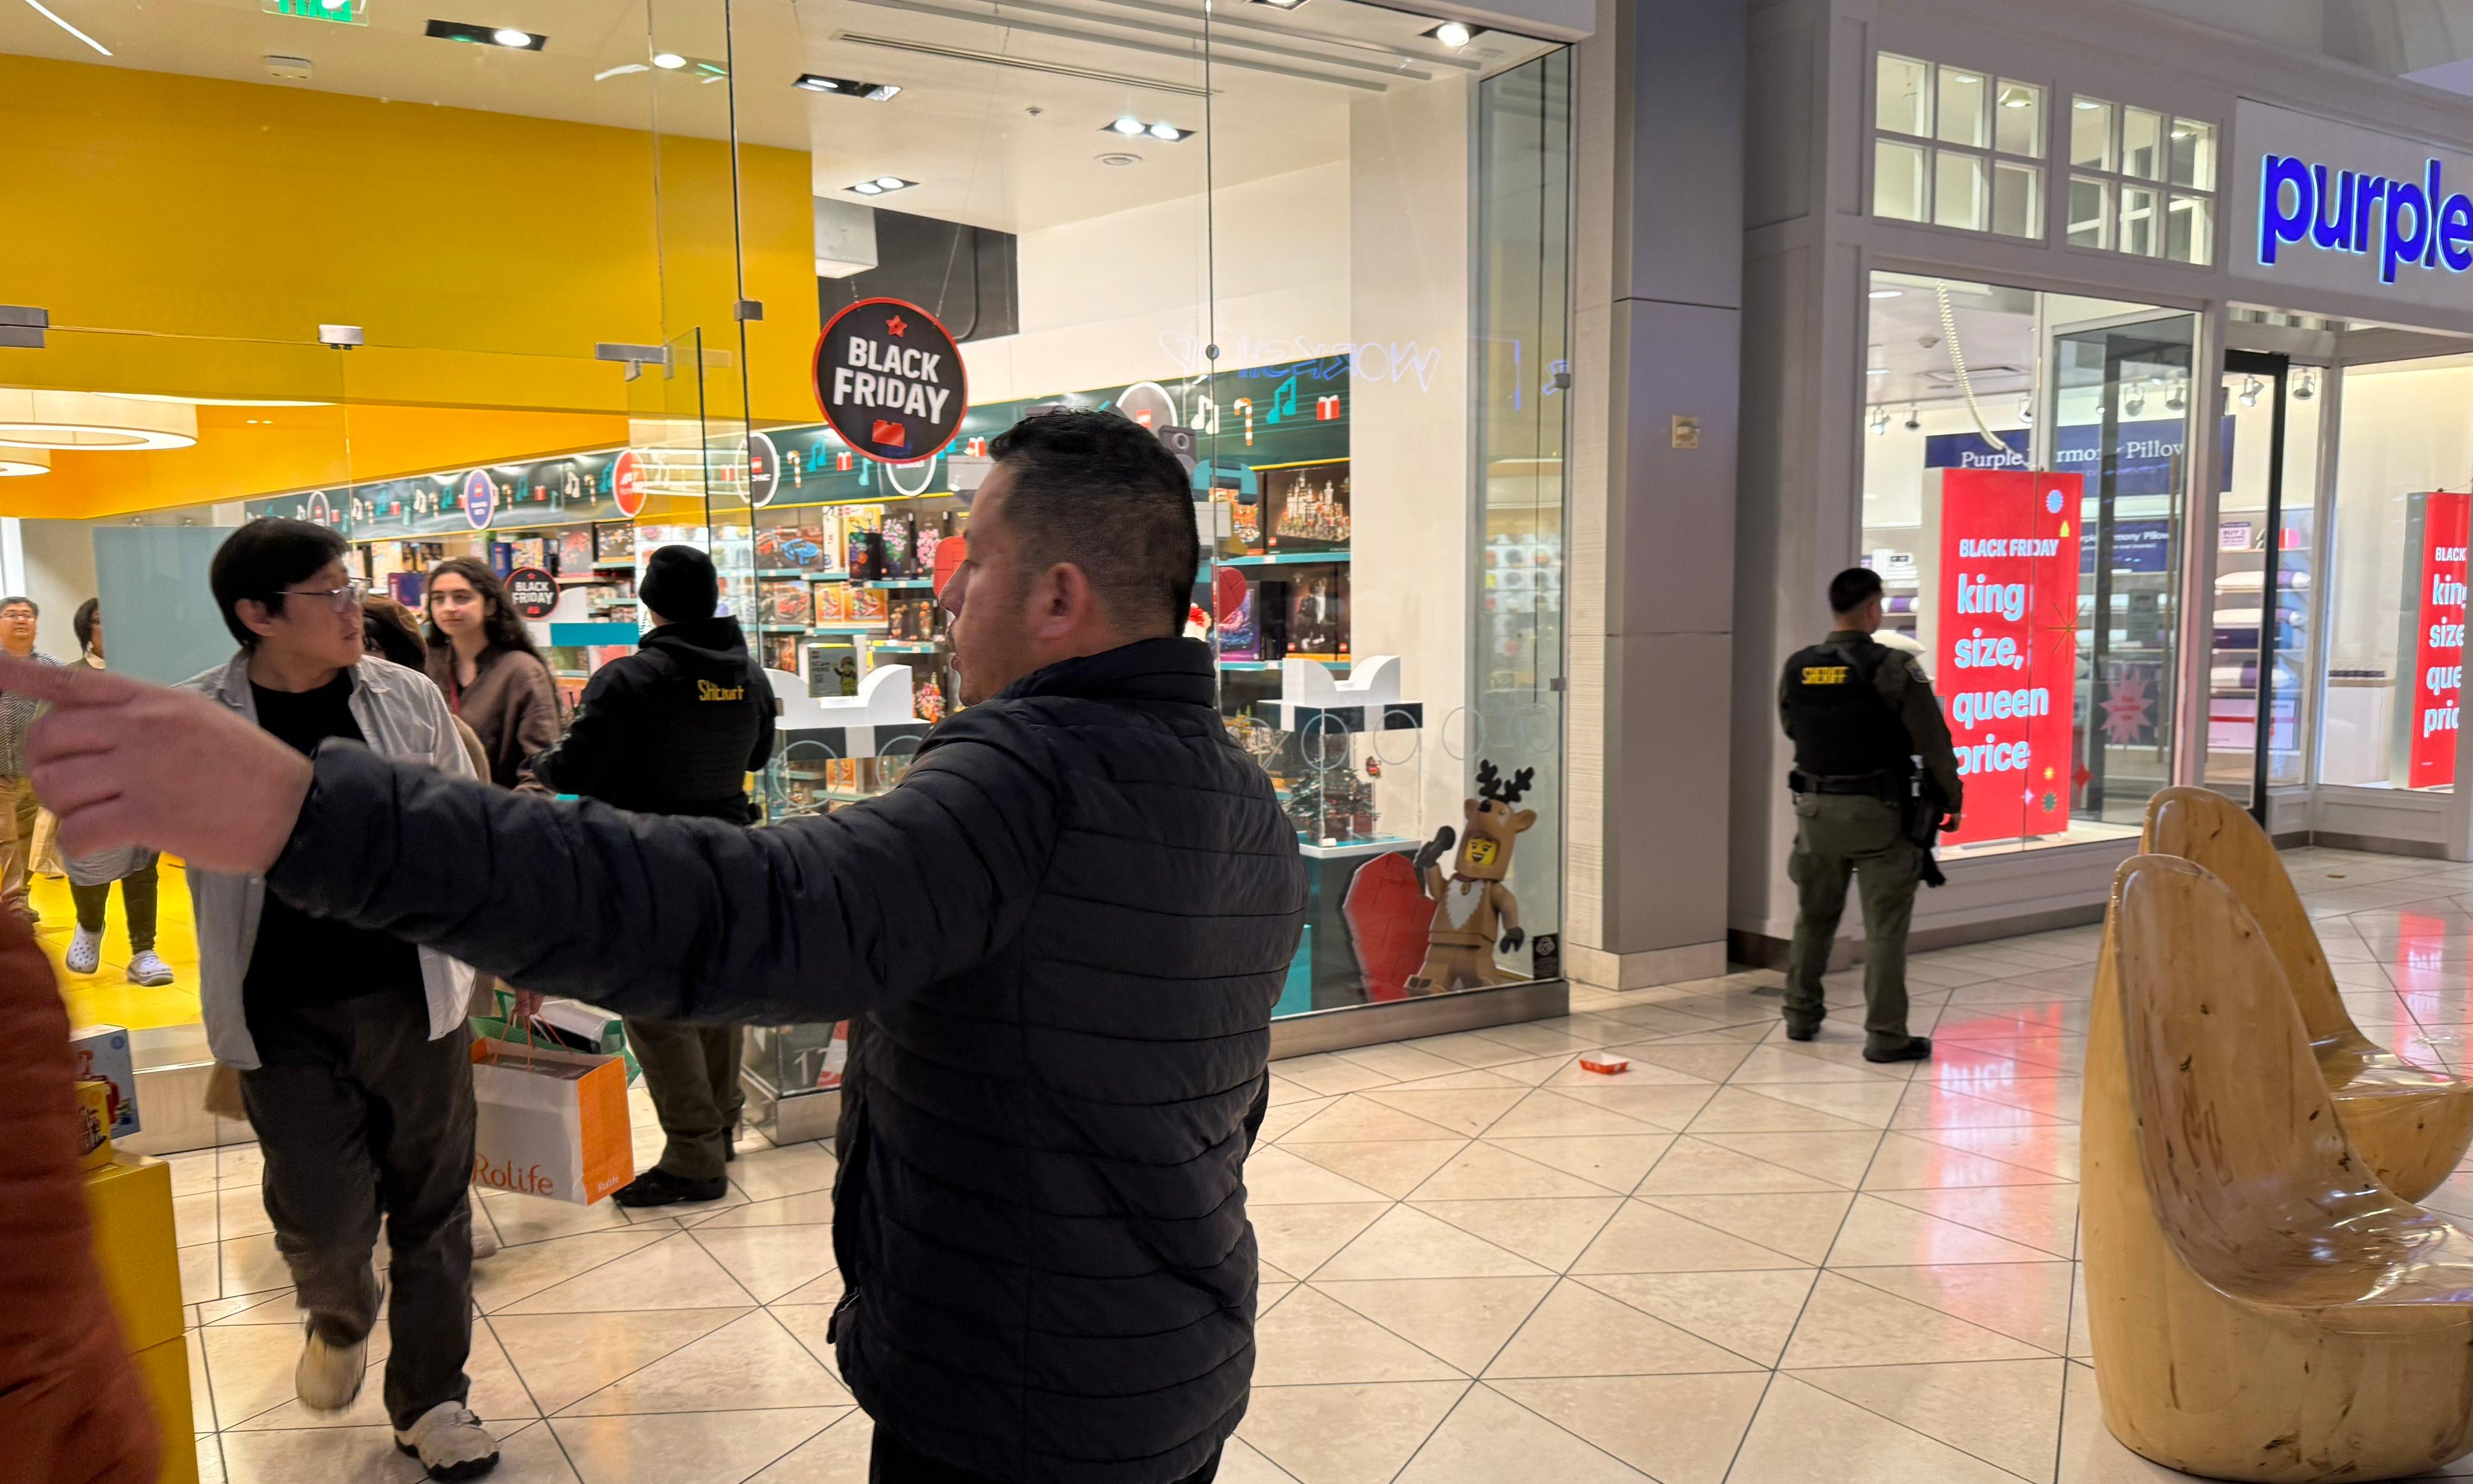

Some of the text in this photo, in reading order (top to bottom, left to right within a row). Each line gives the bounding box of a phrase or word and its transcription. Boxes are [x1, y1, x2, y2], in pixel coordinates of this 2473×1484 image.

[2257, 154, 2473, 284] purple
[848, 336, 941, 383] BLACK
[833, 366, 950, 424] FRIDAY
[1960, 539, 2008, 557] BLACK
[2009, 539, 2059, 557] FRIDAY
[2435, 547, 2467, 561] BLACK
[511, 592, 554, 605] FRIDAY
[515, 581, 550, 592] BLACK
[1957, 573, 2025, 622] king
[1954, 627, 2024, 670] size,
[2427, 666, 2462, 696] que
[1953, 688, 2049, 729] queen
[2423, 700, 2460, 738] pric
[472, 1153, 554, 1196] Rolife
